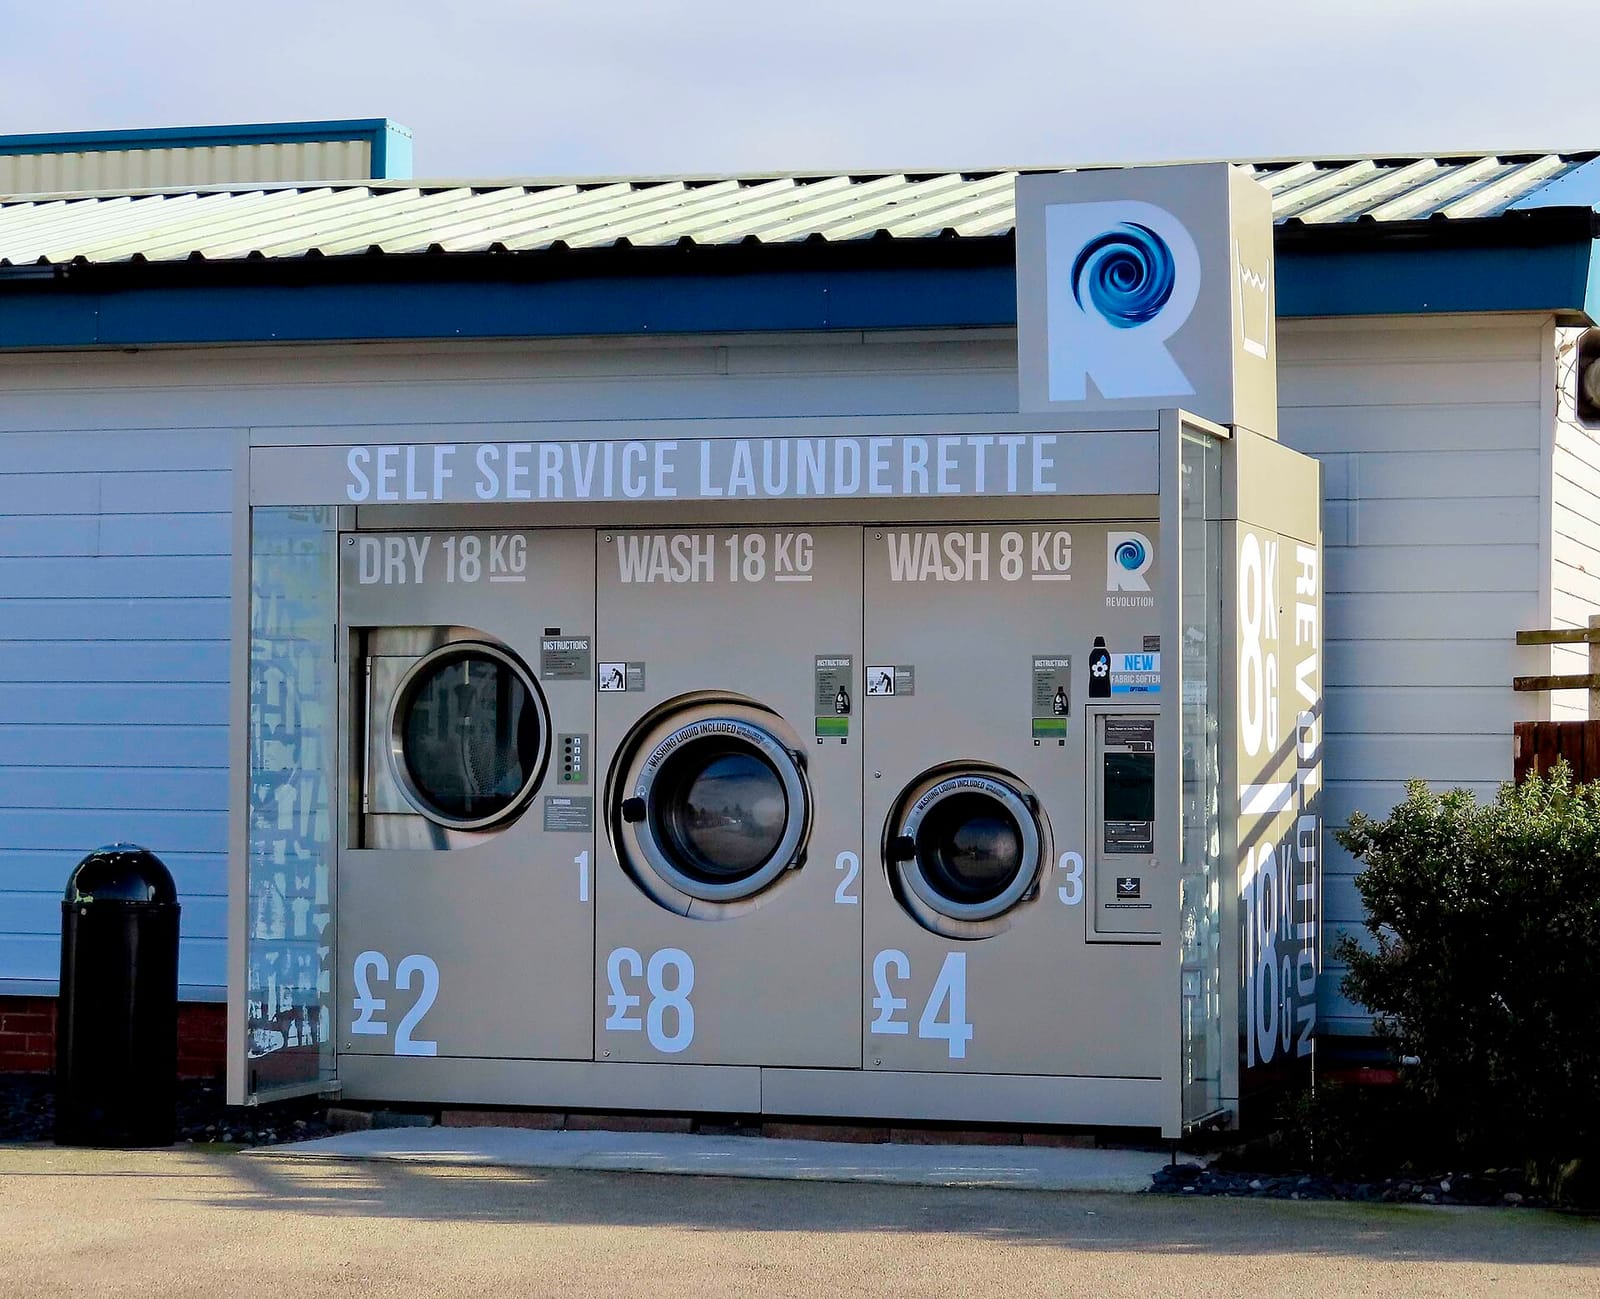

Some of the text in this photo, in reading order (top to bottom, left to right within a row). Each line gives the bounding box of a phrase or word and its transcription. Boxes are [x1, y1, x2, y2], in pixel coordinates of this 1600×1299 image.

[346, 435, 1057, 501] SELF SERVICE LAUNDERETTE
[359, 534, 527, 584] DRY 18 KG
[617, 532, 813, 582] WASH 18 KG
[887, 531, 1072, 581] WASH 8 KG
[1105, 596, 1154, 608] REVOLUTION
[543, 640, 588, 650] INSTRUCTIONS
[1125, 654, 1154, 671] NEW
[1240, 532, 1264, 757] 8
[1112, 674, 1135, 684] FABRIC
[648, 723, 737, 769] WASHING LIQUID INCLUDED
[917, 779, 985, 811] WASHING LIQUID INCLUDED
[1296, 544, 1318, 1059] REVOLUTION
[574, 850, 588, 902] 1
[834, 851, 859, 904] 2
[1058, 851, 1084, 905] 3
[351, 950, 440, 1057] £2
[605, 947, 695, 1053] £8
[871, 949, 973, 1059] £4
